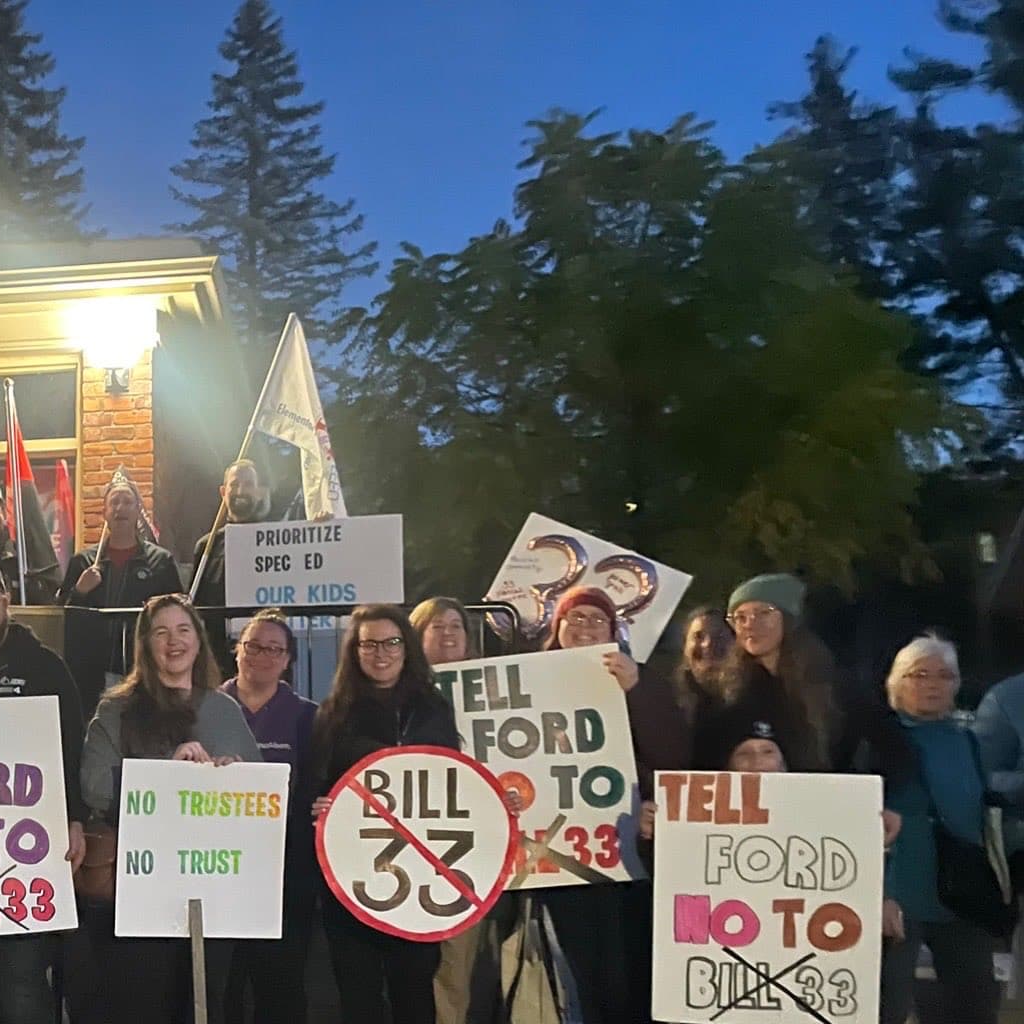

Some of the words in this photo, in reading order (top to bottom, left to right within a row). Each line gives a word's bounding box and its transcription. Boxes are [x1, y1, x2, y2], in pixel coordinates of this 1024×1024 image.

[256, 525, 342, 547] PRIORITIZE
[255, 554, 291, 573] SPEC
[305, 552, 323, 571] ED
[255, 585, 296, 604] OUR
[308, 583, 357, 603] KIDS
[287, 615, 332, 629] TTER
[435, 664, 532, 713] TELL
[472, 708, 605, 763] FORD
[127, 790, 156, 815] NO
[178, 790, 281, 818] TRUSTEES
[363, 768, 470, 819] BILL
[550, 765, 625, 809] TO
[659, 773, 769, 825] TELL
[126, 850, 154, 875] NO
[178, 850, 242, 875] TRUST
[564, 824, 619, 869] 33
[705, 834, 857, 891] FORD
[352, 828, 475, 917] 33
[1, 877, 56, 922] 33
[674, 894, 760, 947] NO
[772, 898, 862, 952] TO
[686, 956, 782, 1010] BILL
[796, 966, 857, 1016] 33
